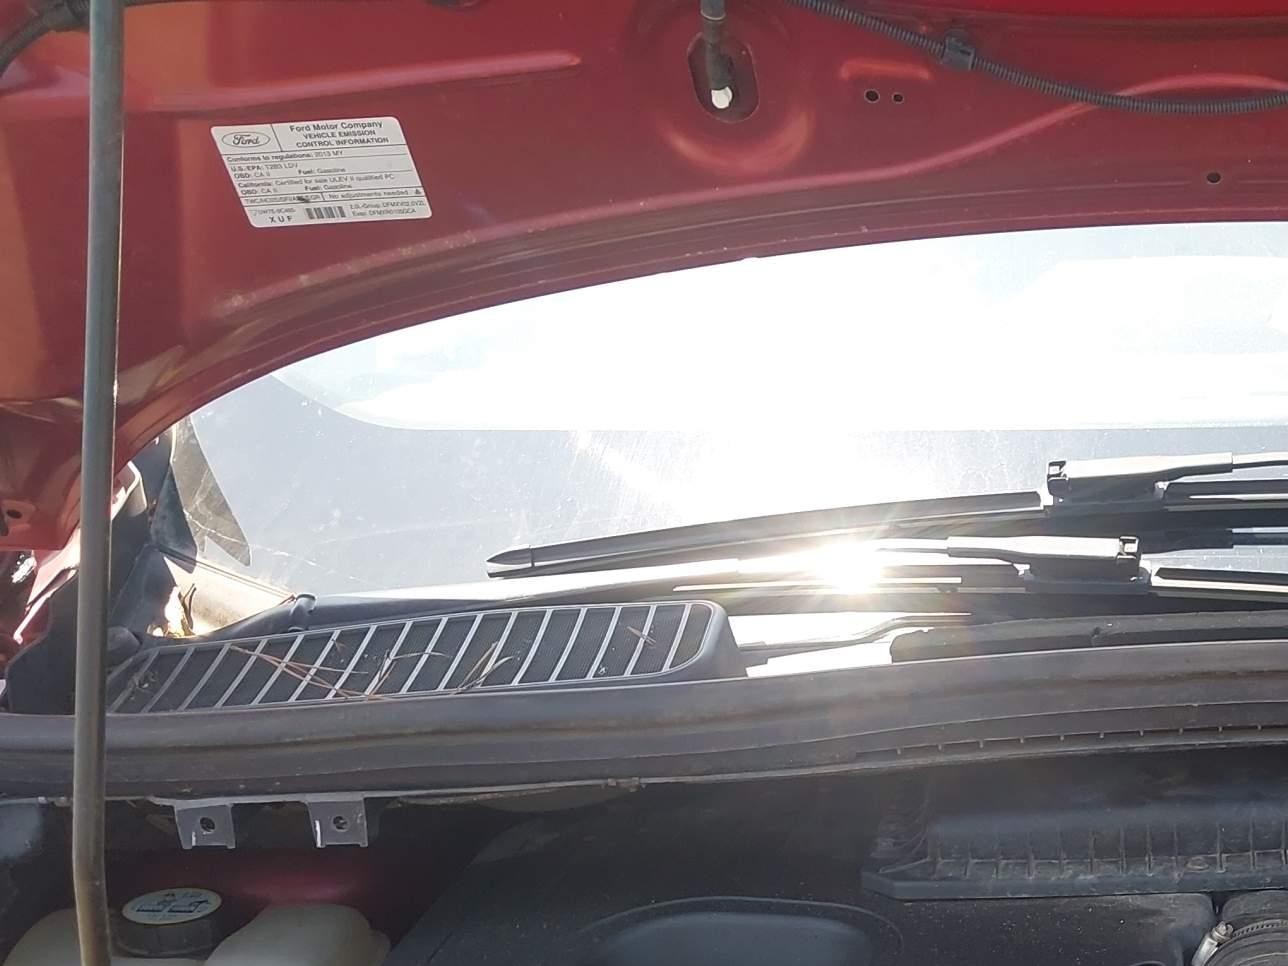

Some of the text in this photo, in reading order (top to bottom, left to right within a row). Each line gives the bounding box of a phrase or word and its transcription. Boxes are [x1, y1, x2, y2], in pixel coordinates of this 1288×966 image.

[289, 121, 382, 132] Ford Motor Company
[232, 134, 260, 145] Ford
[303, 130, 376, 139] VEHICLE EMISSION
[296, 137, 389, 148] CONTROL INFORMATION
[271, 152, 313, 161] regulations:
